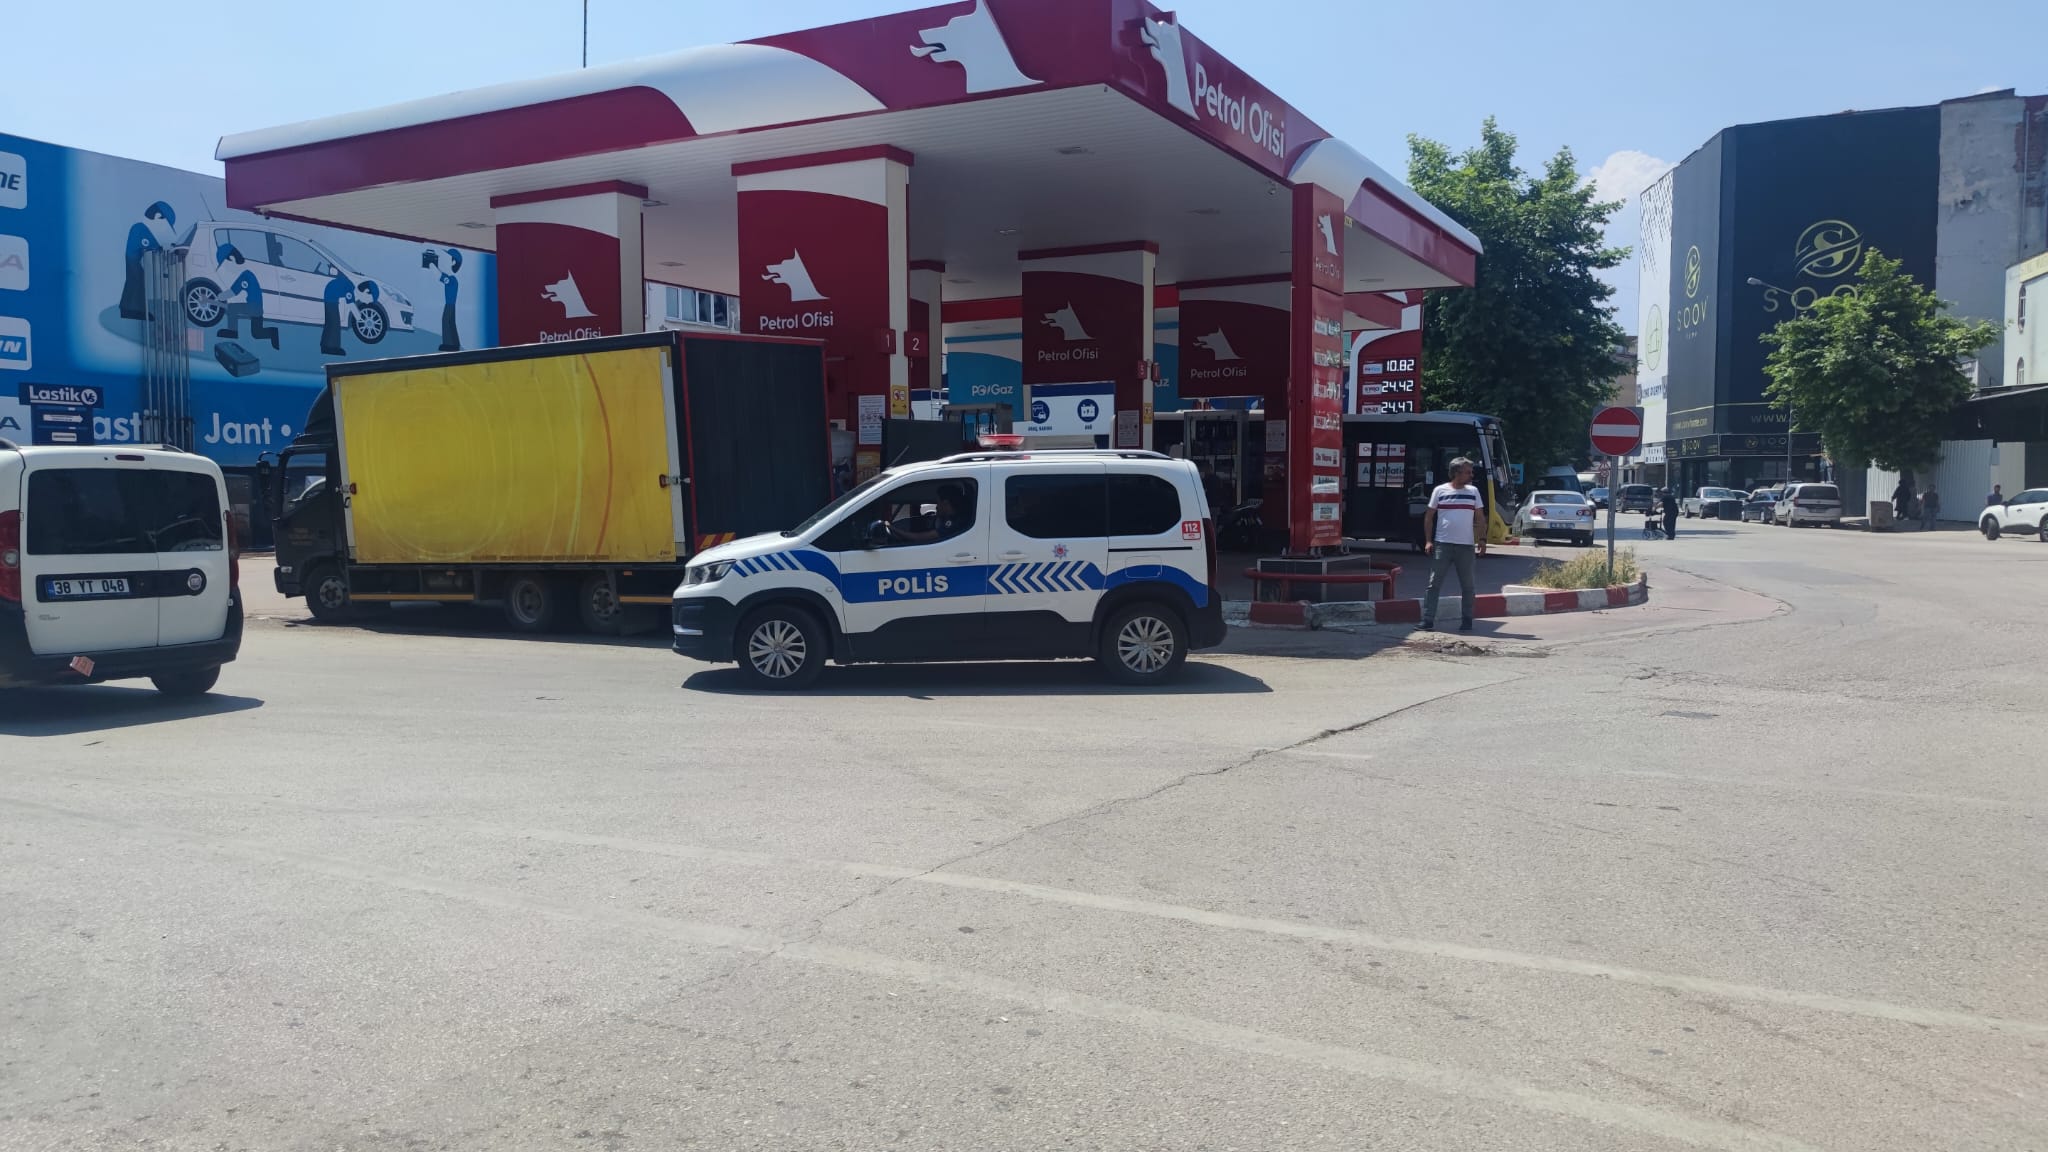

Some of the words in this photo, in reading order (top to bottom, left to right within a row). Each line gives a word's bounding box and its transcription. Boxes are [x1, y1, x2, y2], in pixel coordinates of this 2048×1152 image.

[1195, 62, 1245, 135] Petrol
[1249, 102, 1285, 159] Ofisi
[760, 313, 798, 331] Petrol
[802, 311, 833, 328] Ofisi
[1677, 297, 1708, 332] SOOV
[540, 329, 572, 343] Petrol
[575, 326, 601, 340] Ofisi
[912, 337, 920, 351] 2
[1038, 350, 1070, 362] Petrol
[1072, 348, 1098, 360] Ofisi
[1190, 368, 1220, 379] Petrol
[1222, 366, 1247, 377] Ofisi
[1386, 359, 1415, 372] 10.82
[29, 385, 81, 402] Lastik
[1381, 380, 1414, 393] 24.42
[1381, 400, 1413, 413] 24.47
[204, 412, 272, 445] Jant
[1184, 522, 1198, 533] 112
[55, 581, 72, 595] 38
[78, 581, 93, 593] YT
[102, 579, 125, 592] 048
[878, 572, 949, 595] POLİS
